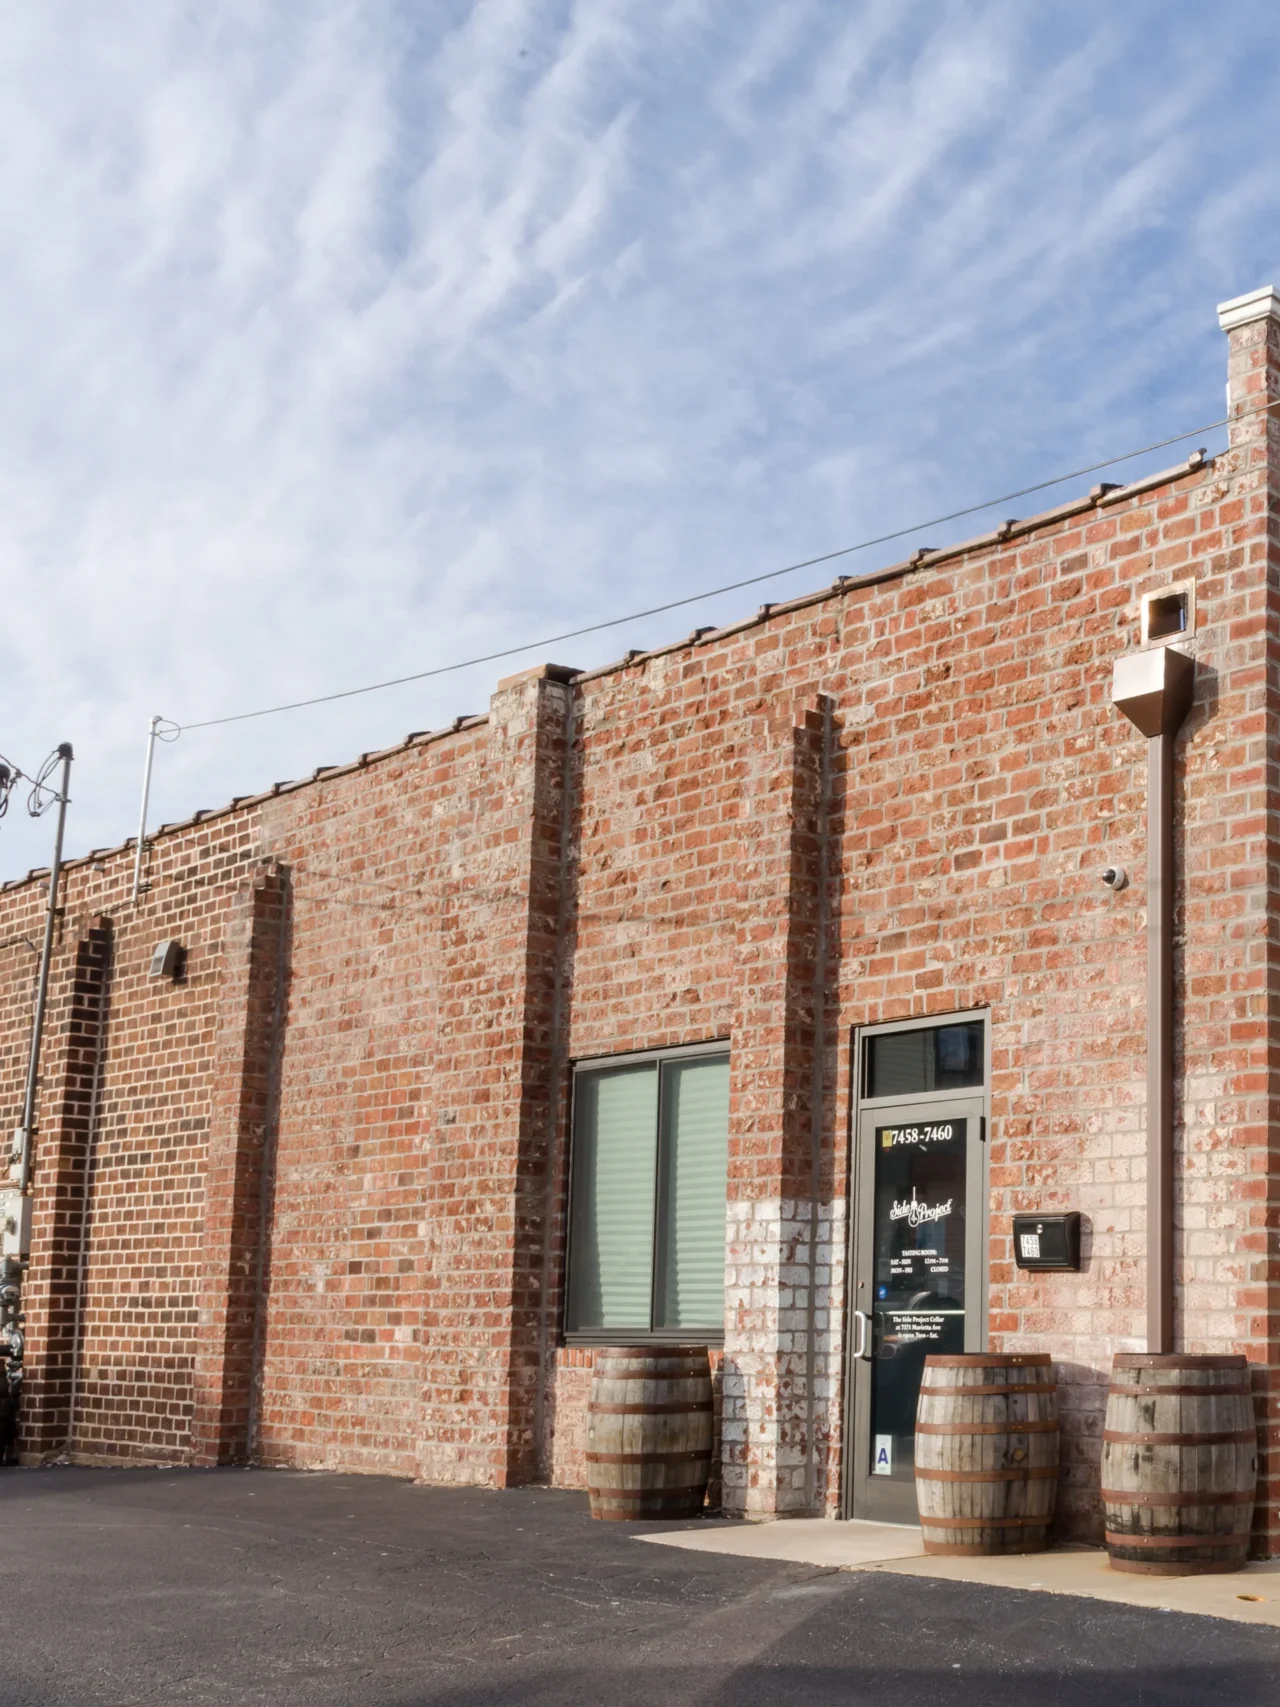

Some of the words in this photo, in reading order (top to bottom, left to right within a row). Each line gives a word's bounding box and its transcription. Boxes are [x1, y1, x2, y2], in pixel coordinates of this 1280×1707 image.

[891, 1125, 953, 1145] 7458-7460
[889, 1199, 910, 1219] Side
[918, 1198, 952, 1222] Project
[1021, 1235, 1038, 1246] 7458
[901, 1249, 920, 1257] TASTING
[1022, 1246, 1039, 1257] 7460
[912, 1315, 929, 1324] Project
[877, 1447, 889, 1464] A
